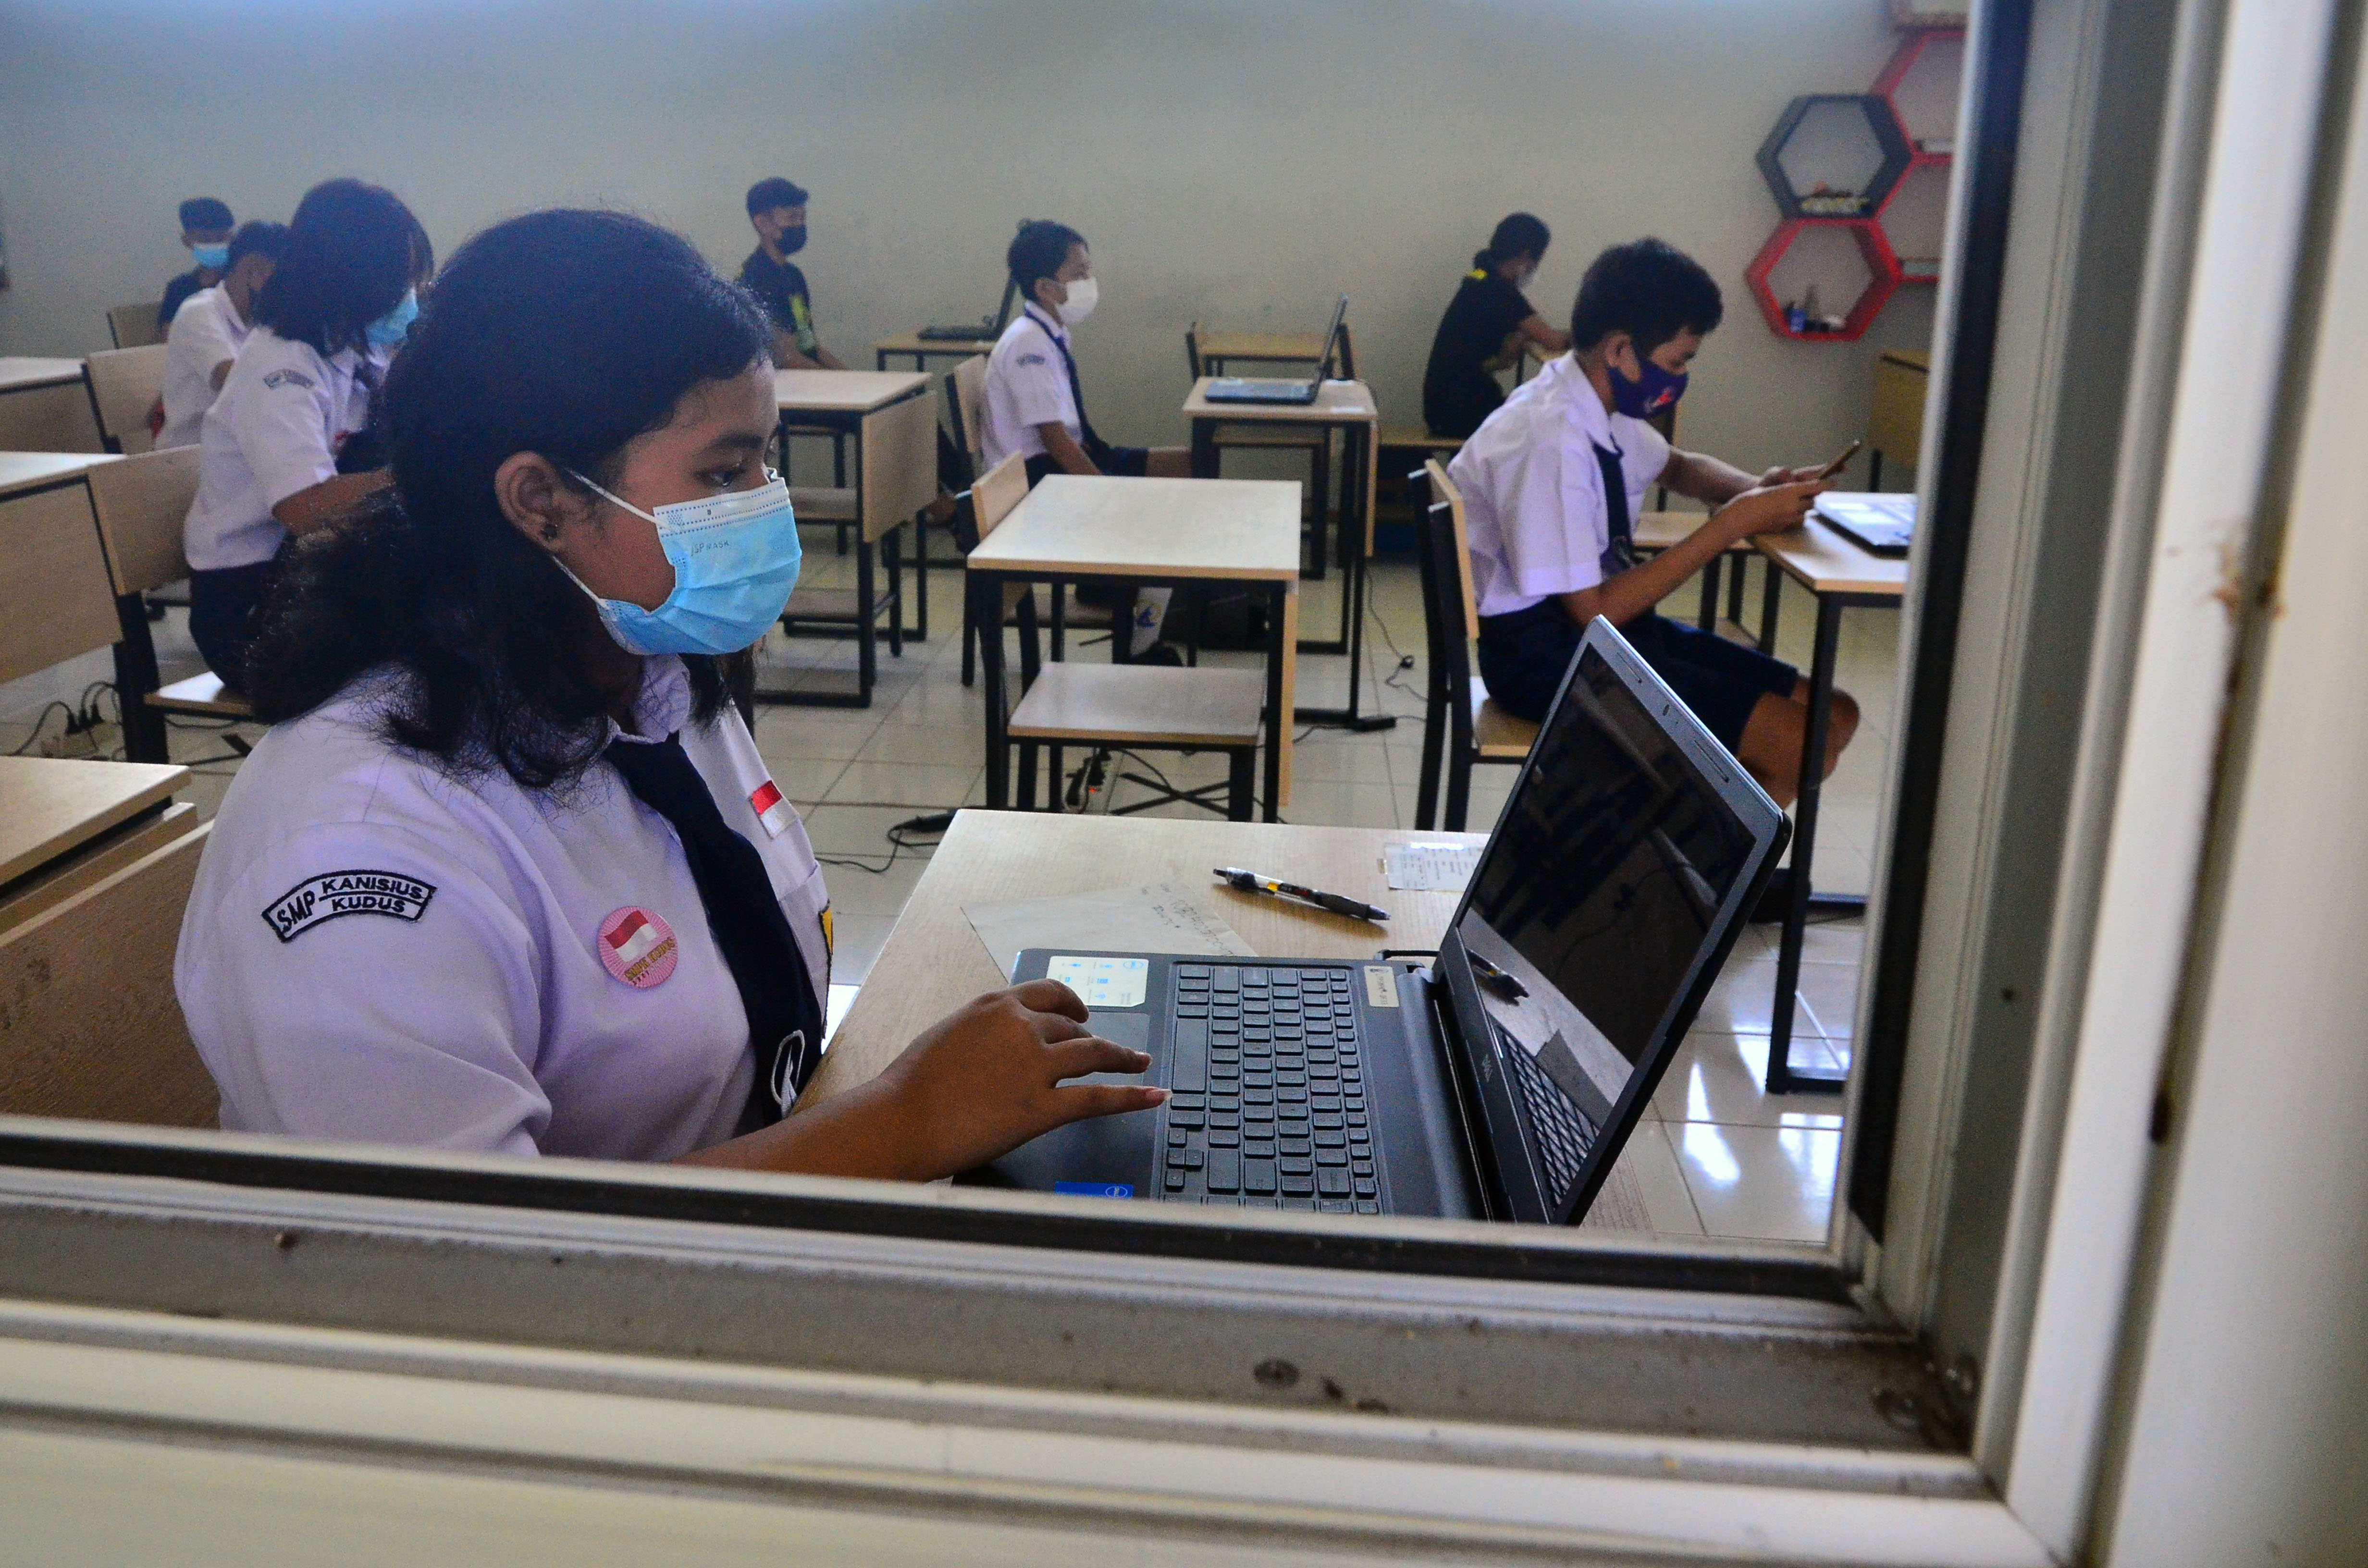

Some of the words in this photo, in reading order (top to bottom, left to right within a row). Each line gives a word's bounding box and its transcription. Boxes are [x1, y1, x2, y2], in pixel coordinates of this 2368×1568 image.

[321, 876, 423, 899] KANISIUS
[277, 890, 315, 931] SMP
[332, 896, 407, 913] KUDUS
